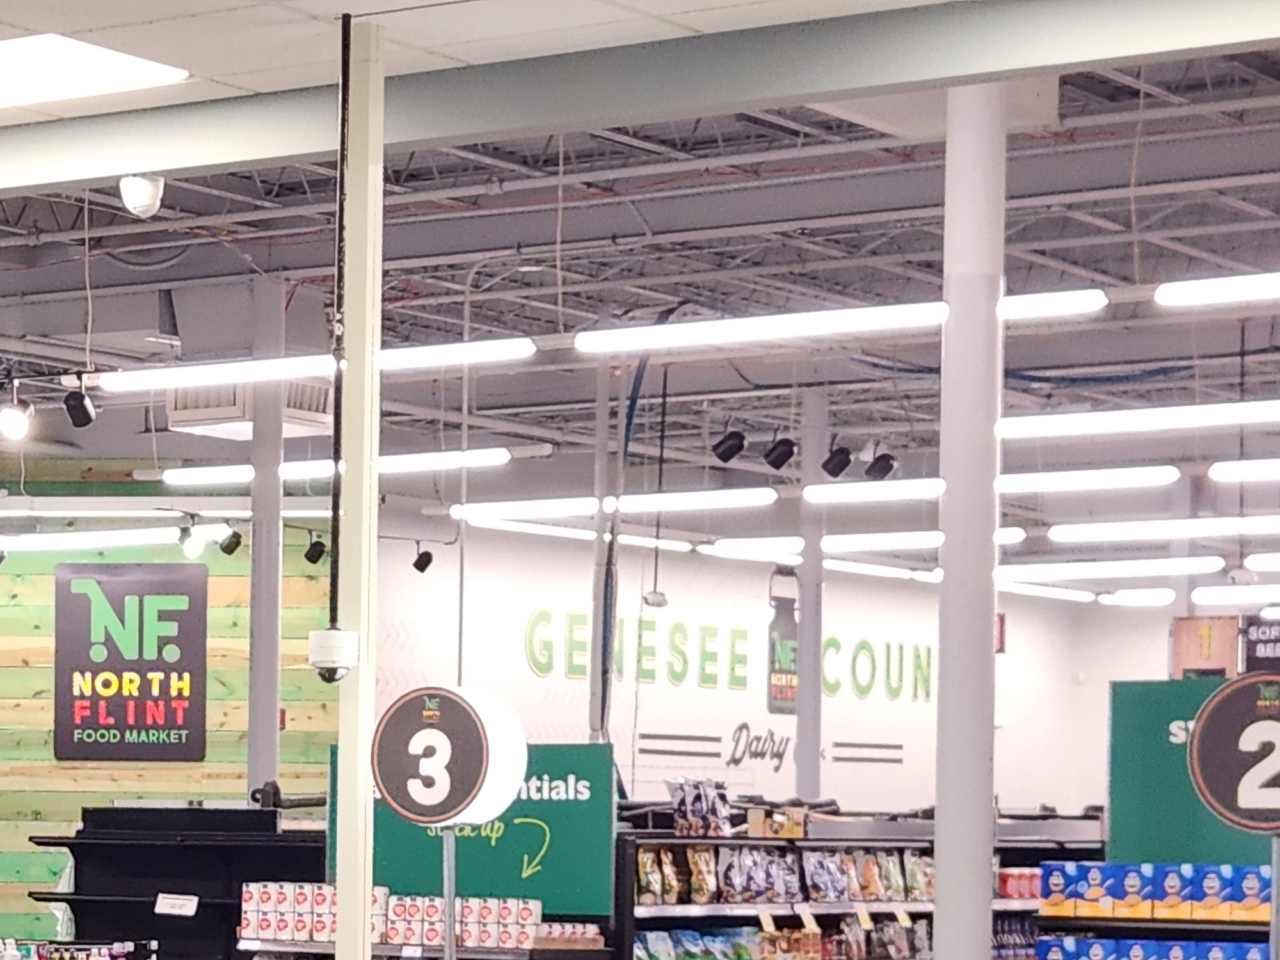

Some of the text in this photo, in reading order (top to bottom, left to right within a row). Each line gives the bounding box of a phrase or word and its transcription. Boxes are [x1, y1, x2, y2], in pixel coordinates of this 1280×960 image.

[1198, 624, 1211, 660] 1
[72, 671, 191, 697] NORTH
[72, 699, 190, 727] FLINT
[73, 729, 189, 744] FOOD MARKET
[726, 722, 791, 773] Dairy
[406, 728, 452, 807] 3
